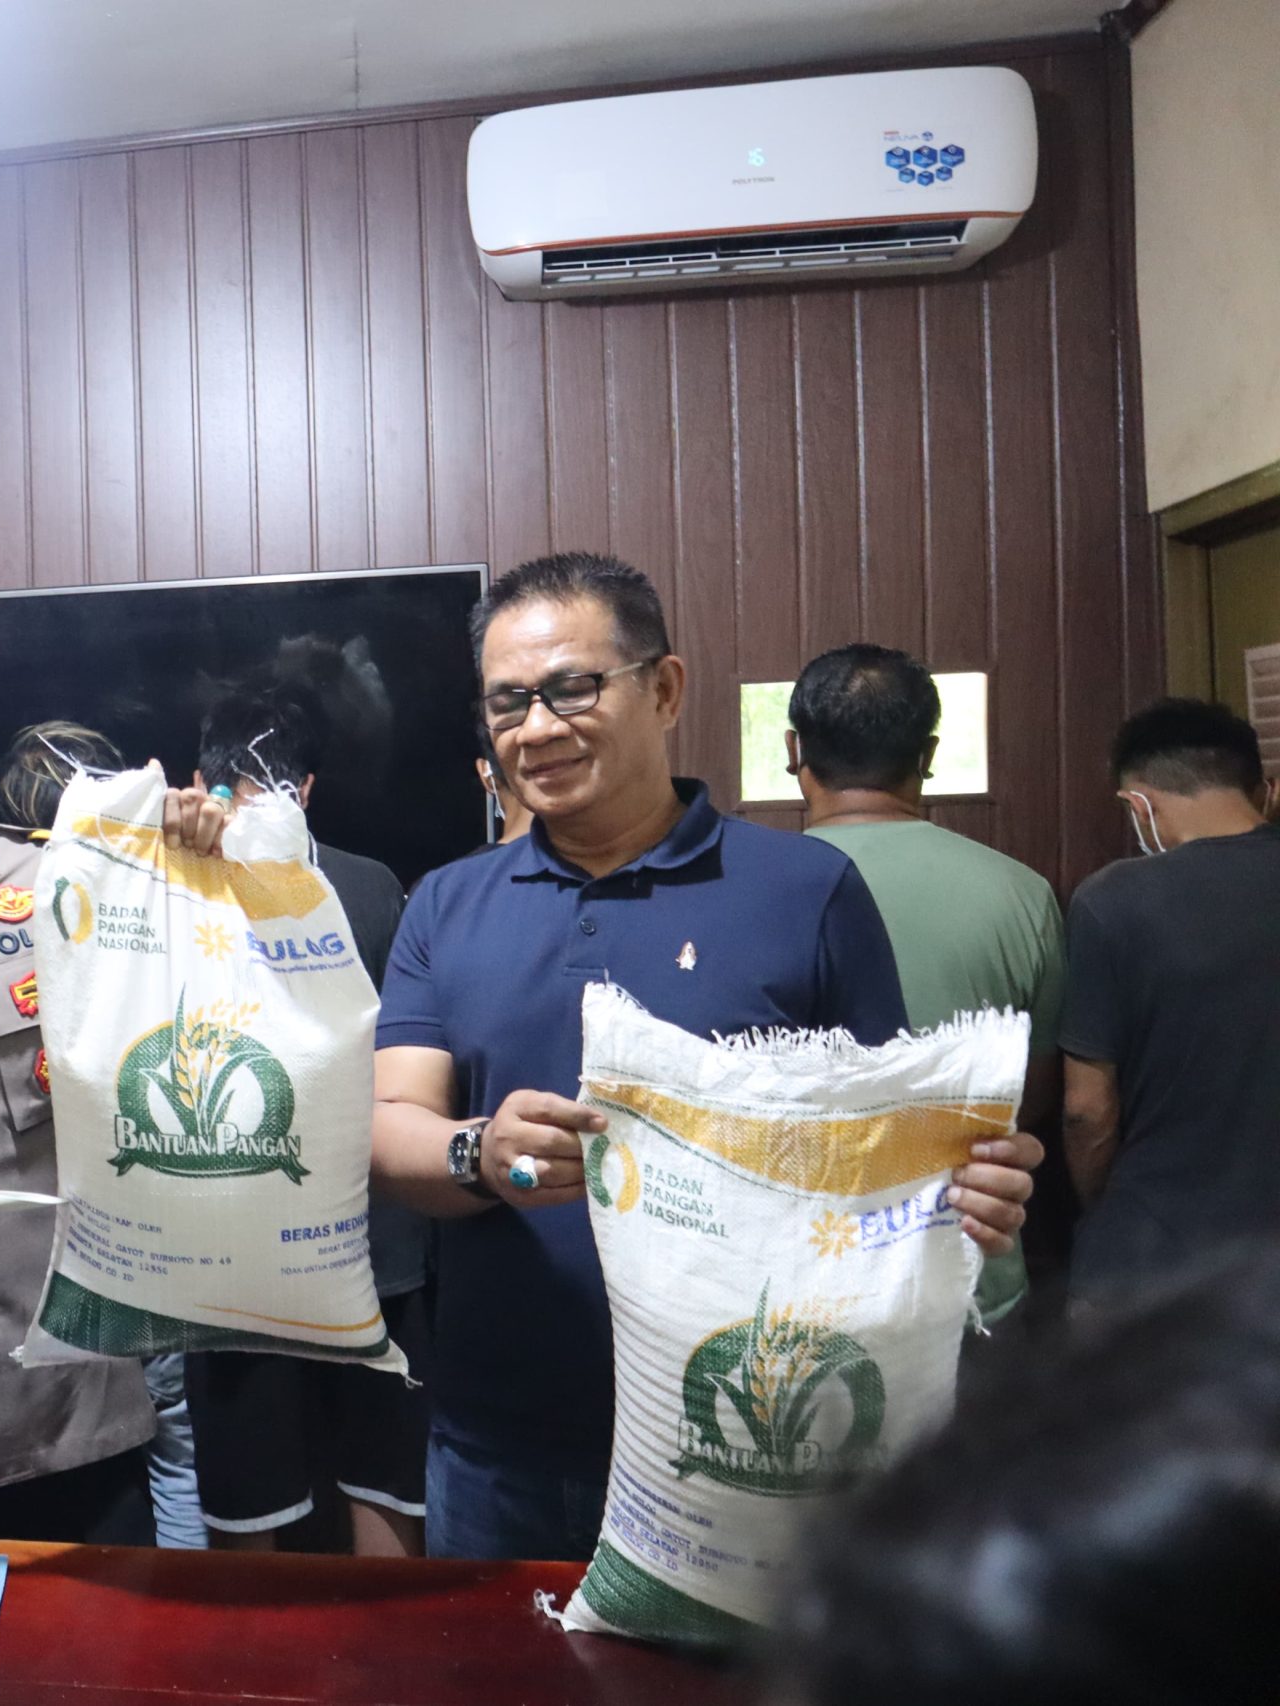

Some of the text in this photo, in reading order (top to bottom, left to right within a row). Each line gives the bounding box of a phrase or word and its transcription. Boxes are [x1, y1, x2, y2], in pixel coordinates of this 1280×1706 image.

[98, 919, 156, 938] PANGAN
[98, 936, 167, 954] NASIONAL
[115, 1114, 302, 1157] BANTUAN PANGAN
[643, 1163, 704, 1197] BADAN
[643, 1182, 714, 1217] PANGAN
[280, 1225, 331, 1242] BERAS
[643, 1200, 730, 1239] NASIONAL
[678, 1416, 785, 1475] BANTUAN
